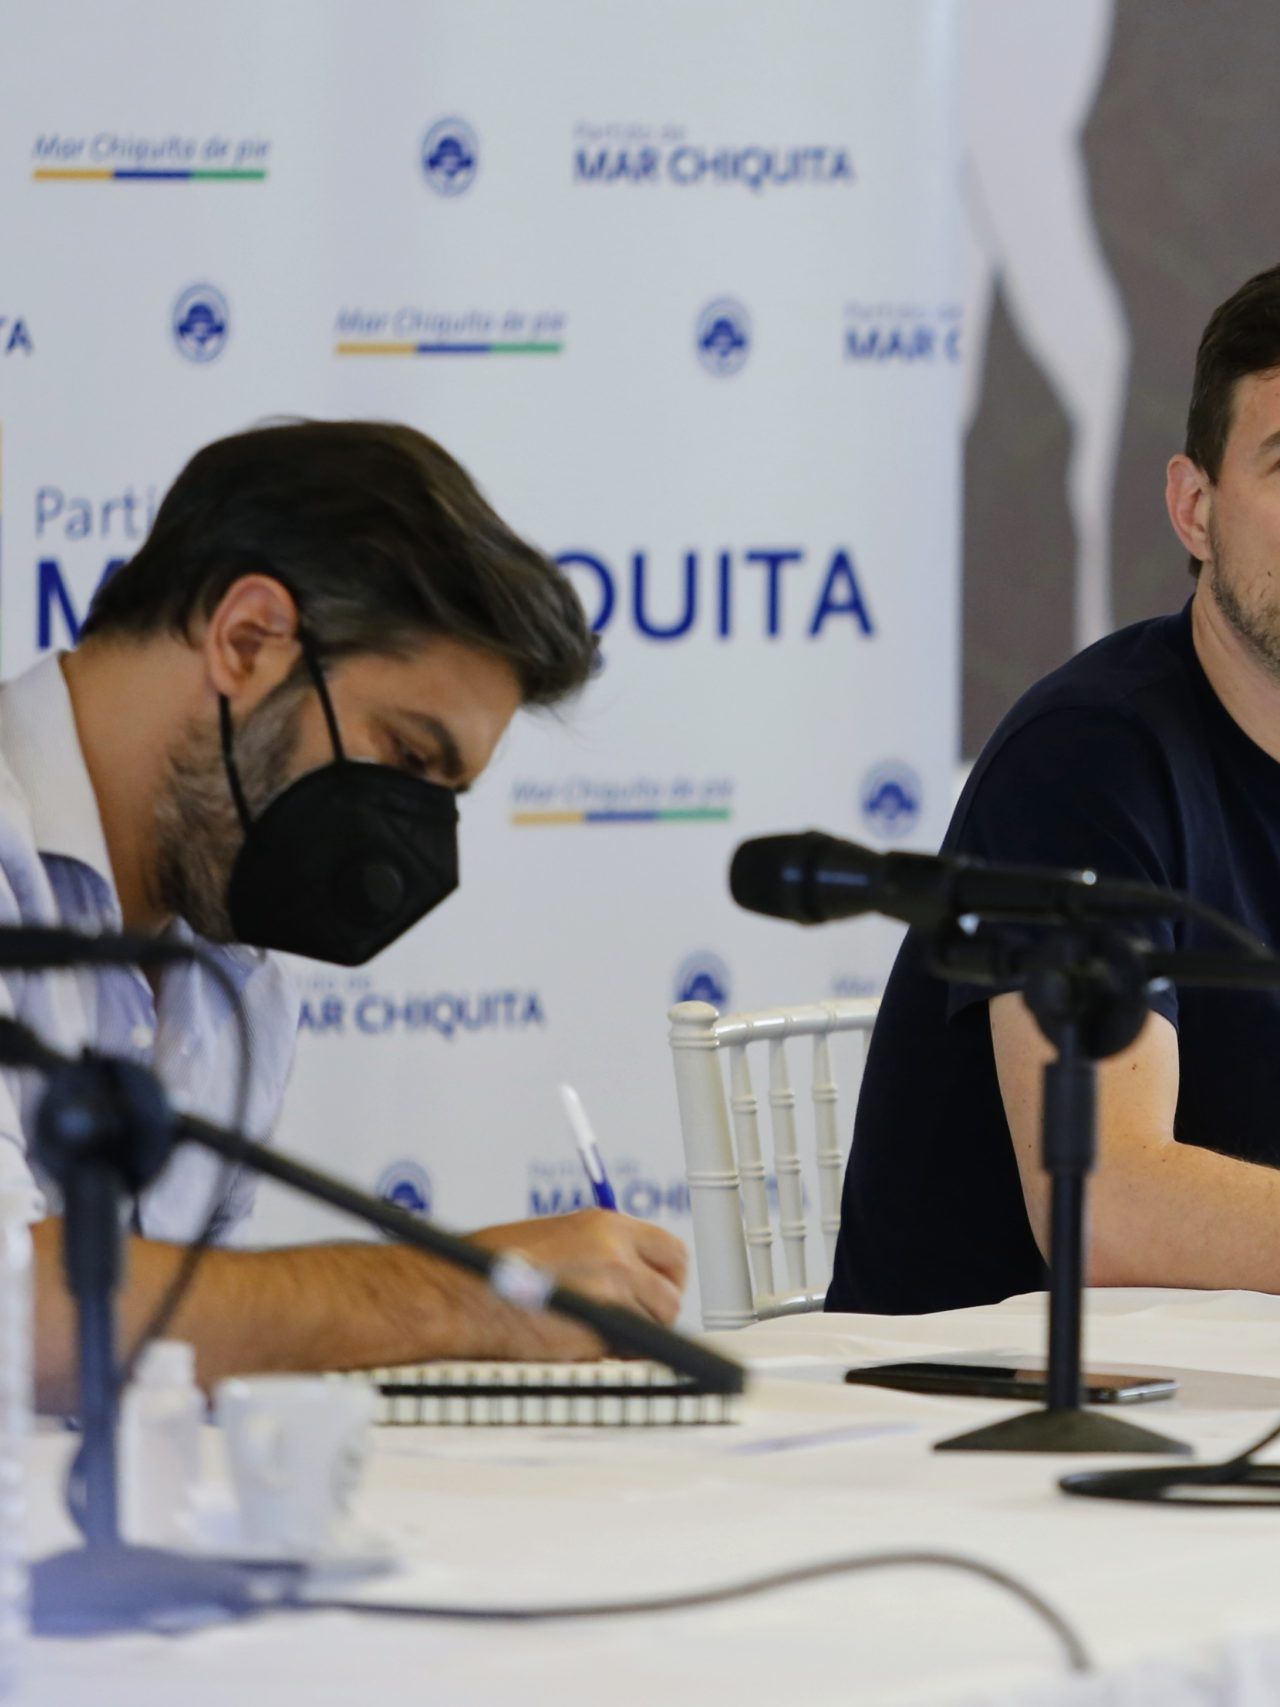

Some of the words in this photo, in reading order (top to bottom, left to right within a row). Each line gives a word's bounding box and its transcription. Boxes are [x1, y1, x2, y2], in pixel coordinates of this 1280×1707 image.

[575, 147, 659, 183] MAR
[668, 147, 855, 194] CHIQUITA
[844, 326, 936, 362] MAR
[35, 483, 158, 541] Parti
[297, 995, 346, 1034] AR
[353, 991, 545, 1042] CHIQUITA
